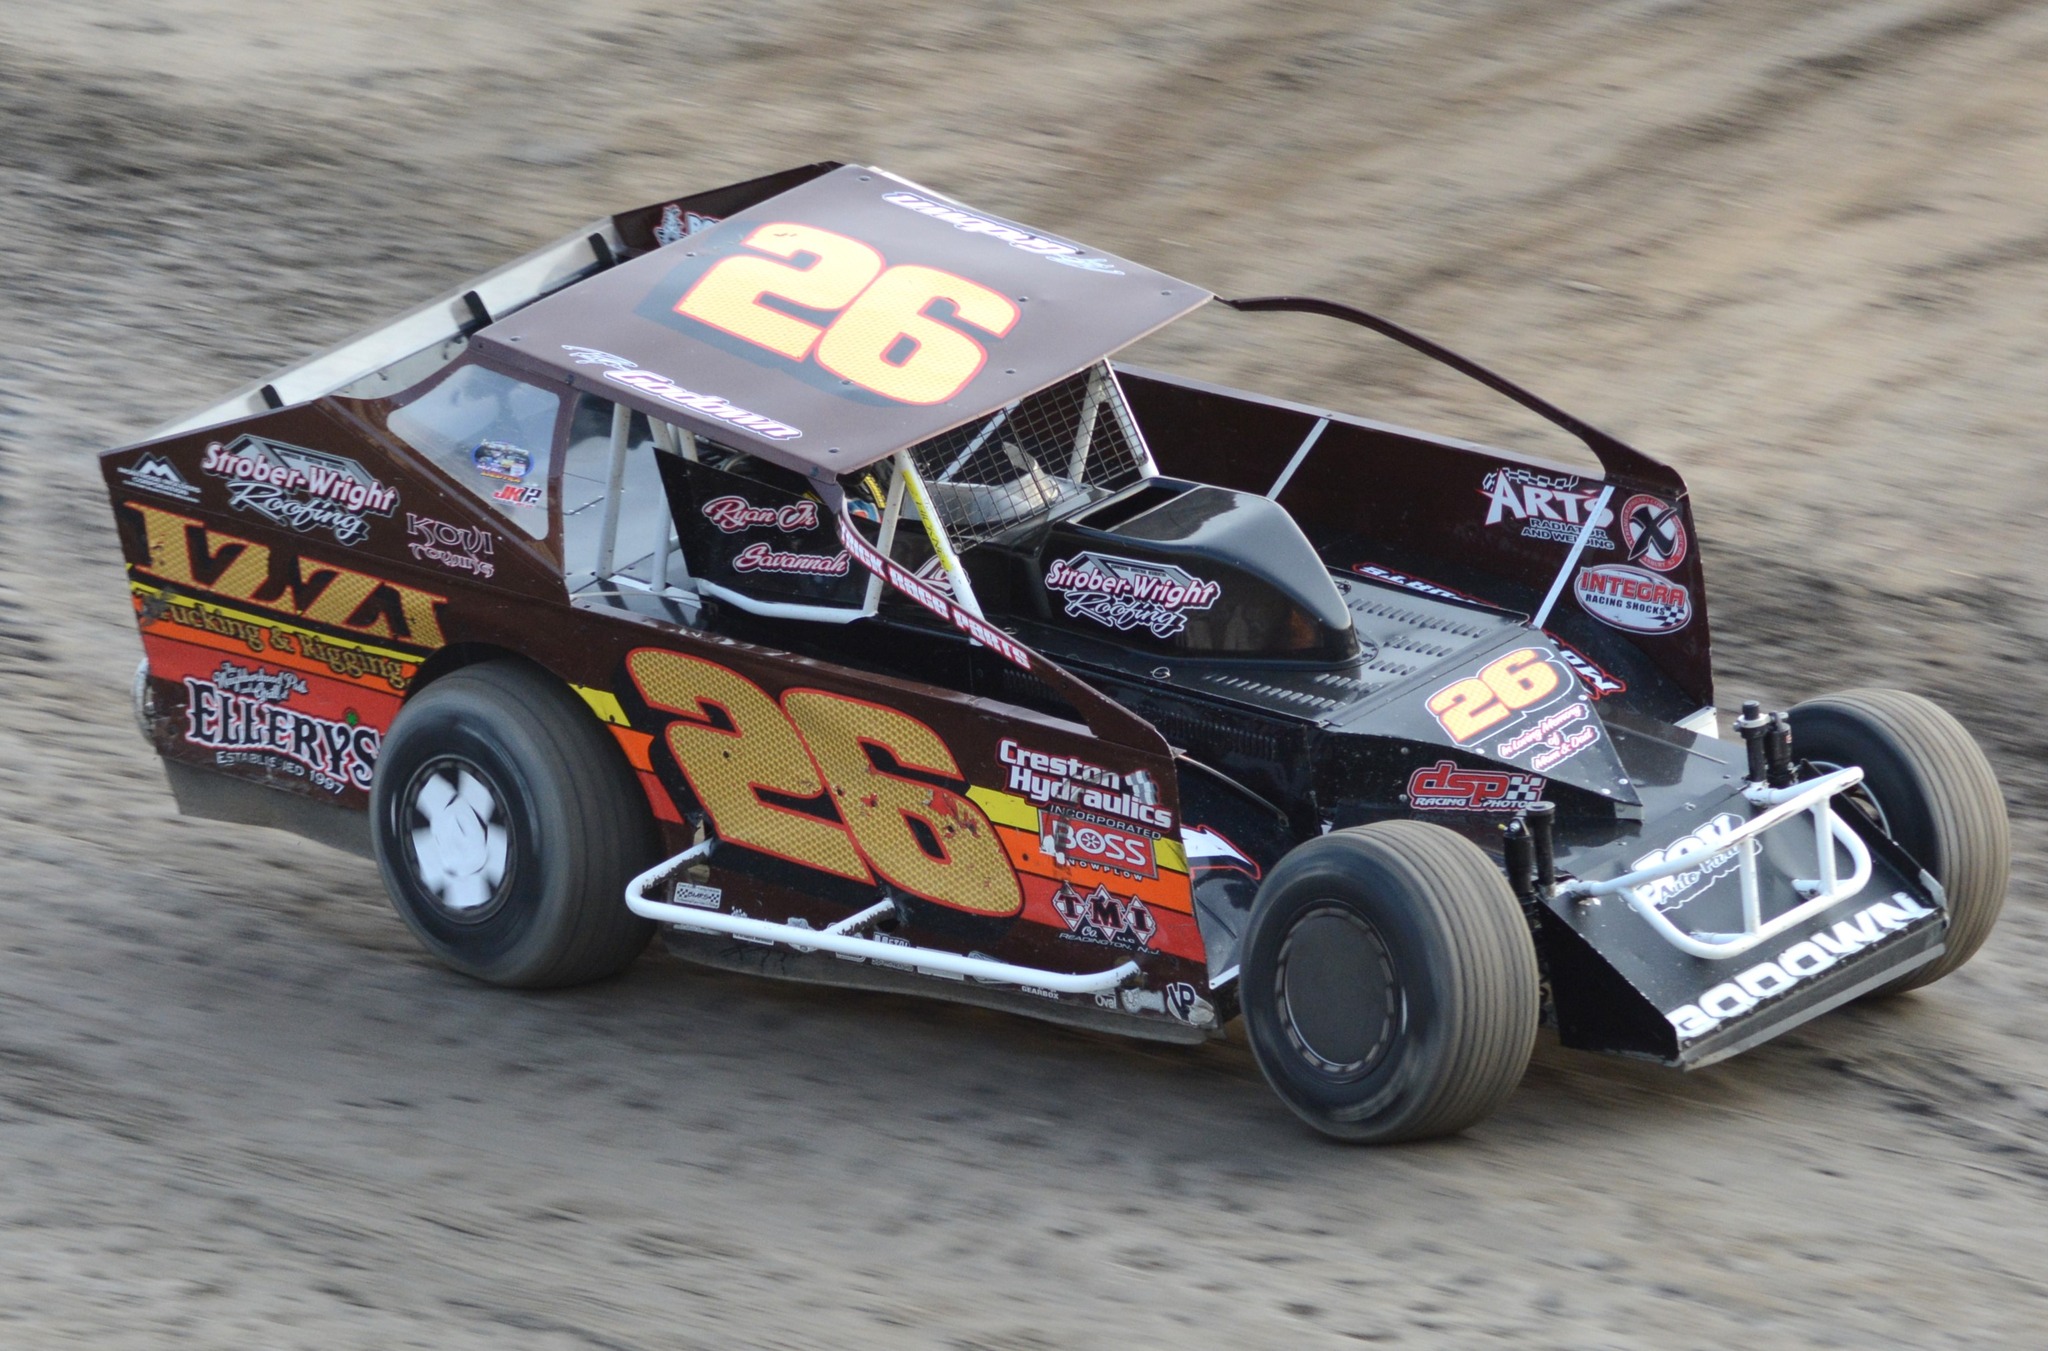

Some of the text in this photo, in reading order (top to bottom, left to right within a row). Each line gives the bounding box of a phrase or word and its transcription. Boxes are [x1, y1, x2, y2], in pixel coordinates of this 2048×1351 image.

[673, 221, 1021, 406] 26
[201, 441, 398, 512] Strober-Wright
[226, 481, 366, 541] Roofing
[702, 496, 819, 534] Ryan Jr
[1521, 528, 1551, 541] AND
[123, 500, 448, 650] IZZI
[733, 542, 850, 578] Savannah
[1046, 560, 1218, 609] Strober-Wright
[1064, 591, 1182, 633] Roofing
[1579, 570, 1687, 608] INTEGRA
[1585, 593, 1666, 617] RACING SHOCKS
[133, 588, 264, 651] ucking
[268, 625, 296, 653] &
[888, 564, 951, 620] RACE
[951, 606, 1033, 671] PARTS
[1427, 647, 1563, 746] 26
[309, 770, 345, 795] 1997
[624, 645, 1025, 919] 26
[999, 738, 1120, 791] Creston
[1008, 764, 1173, 829] Hydraulics
[1414, 796, 1467, 807] RACING
[1050, 804, 1162, 841] INCORPORATED
[1052, 819, 1147, 866] BOSS
[1663, 891, 1936, 1040] GODOWN
[1021, 985, 1060, 1001] GEARBOX
